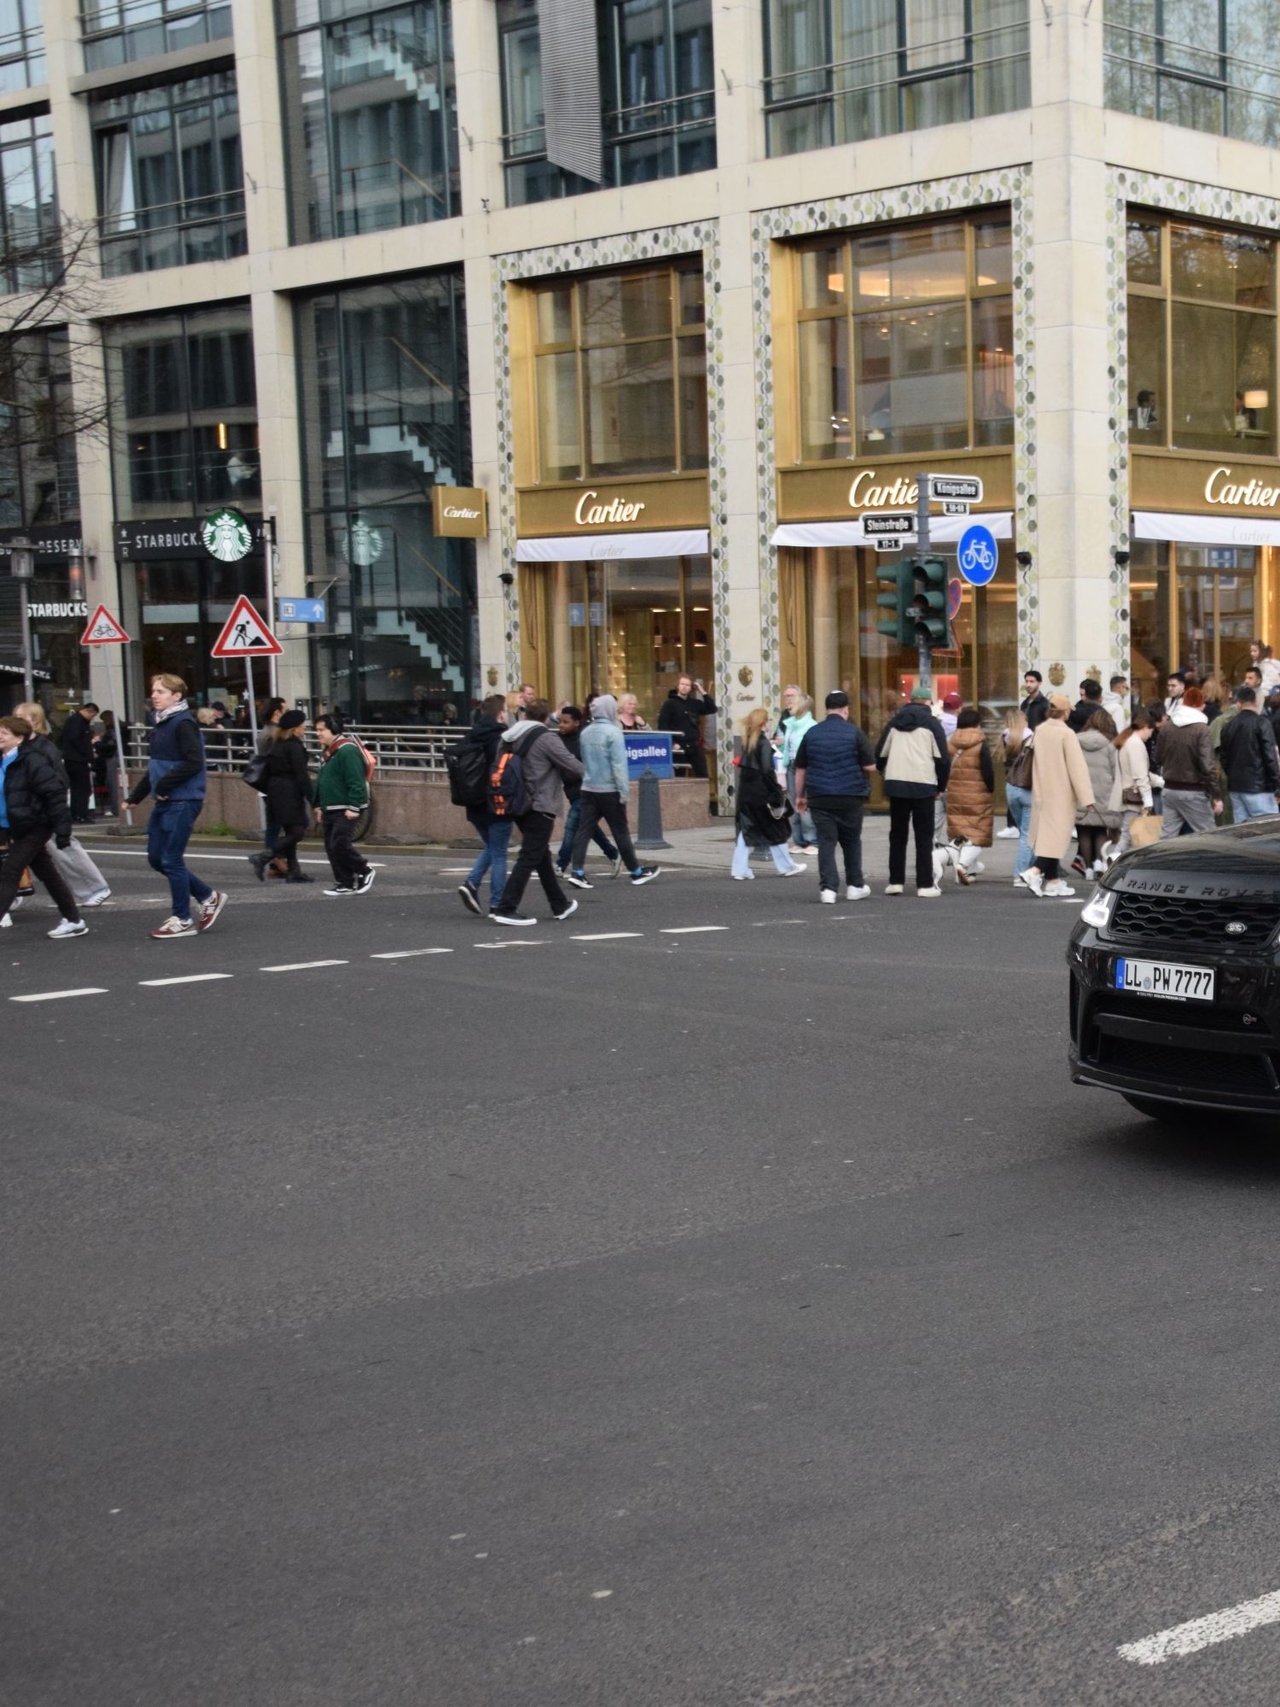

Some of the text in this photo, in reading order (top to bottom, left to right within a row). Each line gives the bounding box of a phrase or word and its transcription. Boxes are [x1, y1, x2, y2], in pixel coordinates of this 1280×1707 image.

[849, 471, 920, 508] Cartie
[936, 481, 977, 497] Königsallee
[443, 506, 482, 520] Cartier
[575, 491, 646, 526] Cartier
[866, 518, 910, 533] Steinstraße
[135, 533, 202, 549] STARBUCK
[27, 602, 88, 618] STARBUCKS
[1127, 879, 1189, 895] RANGE
[1125, 963, 1142, 988] LL
[1153, 967, 1171, 991] PW
[1175, 969, 1212, 996] 7777
